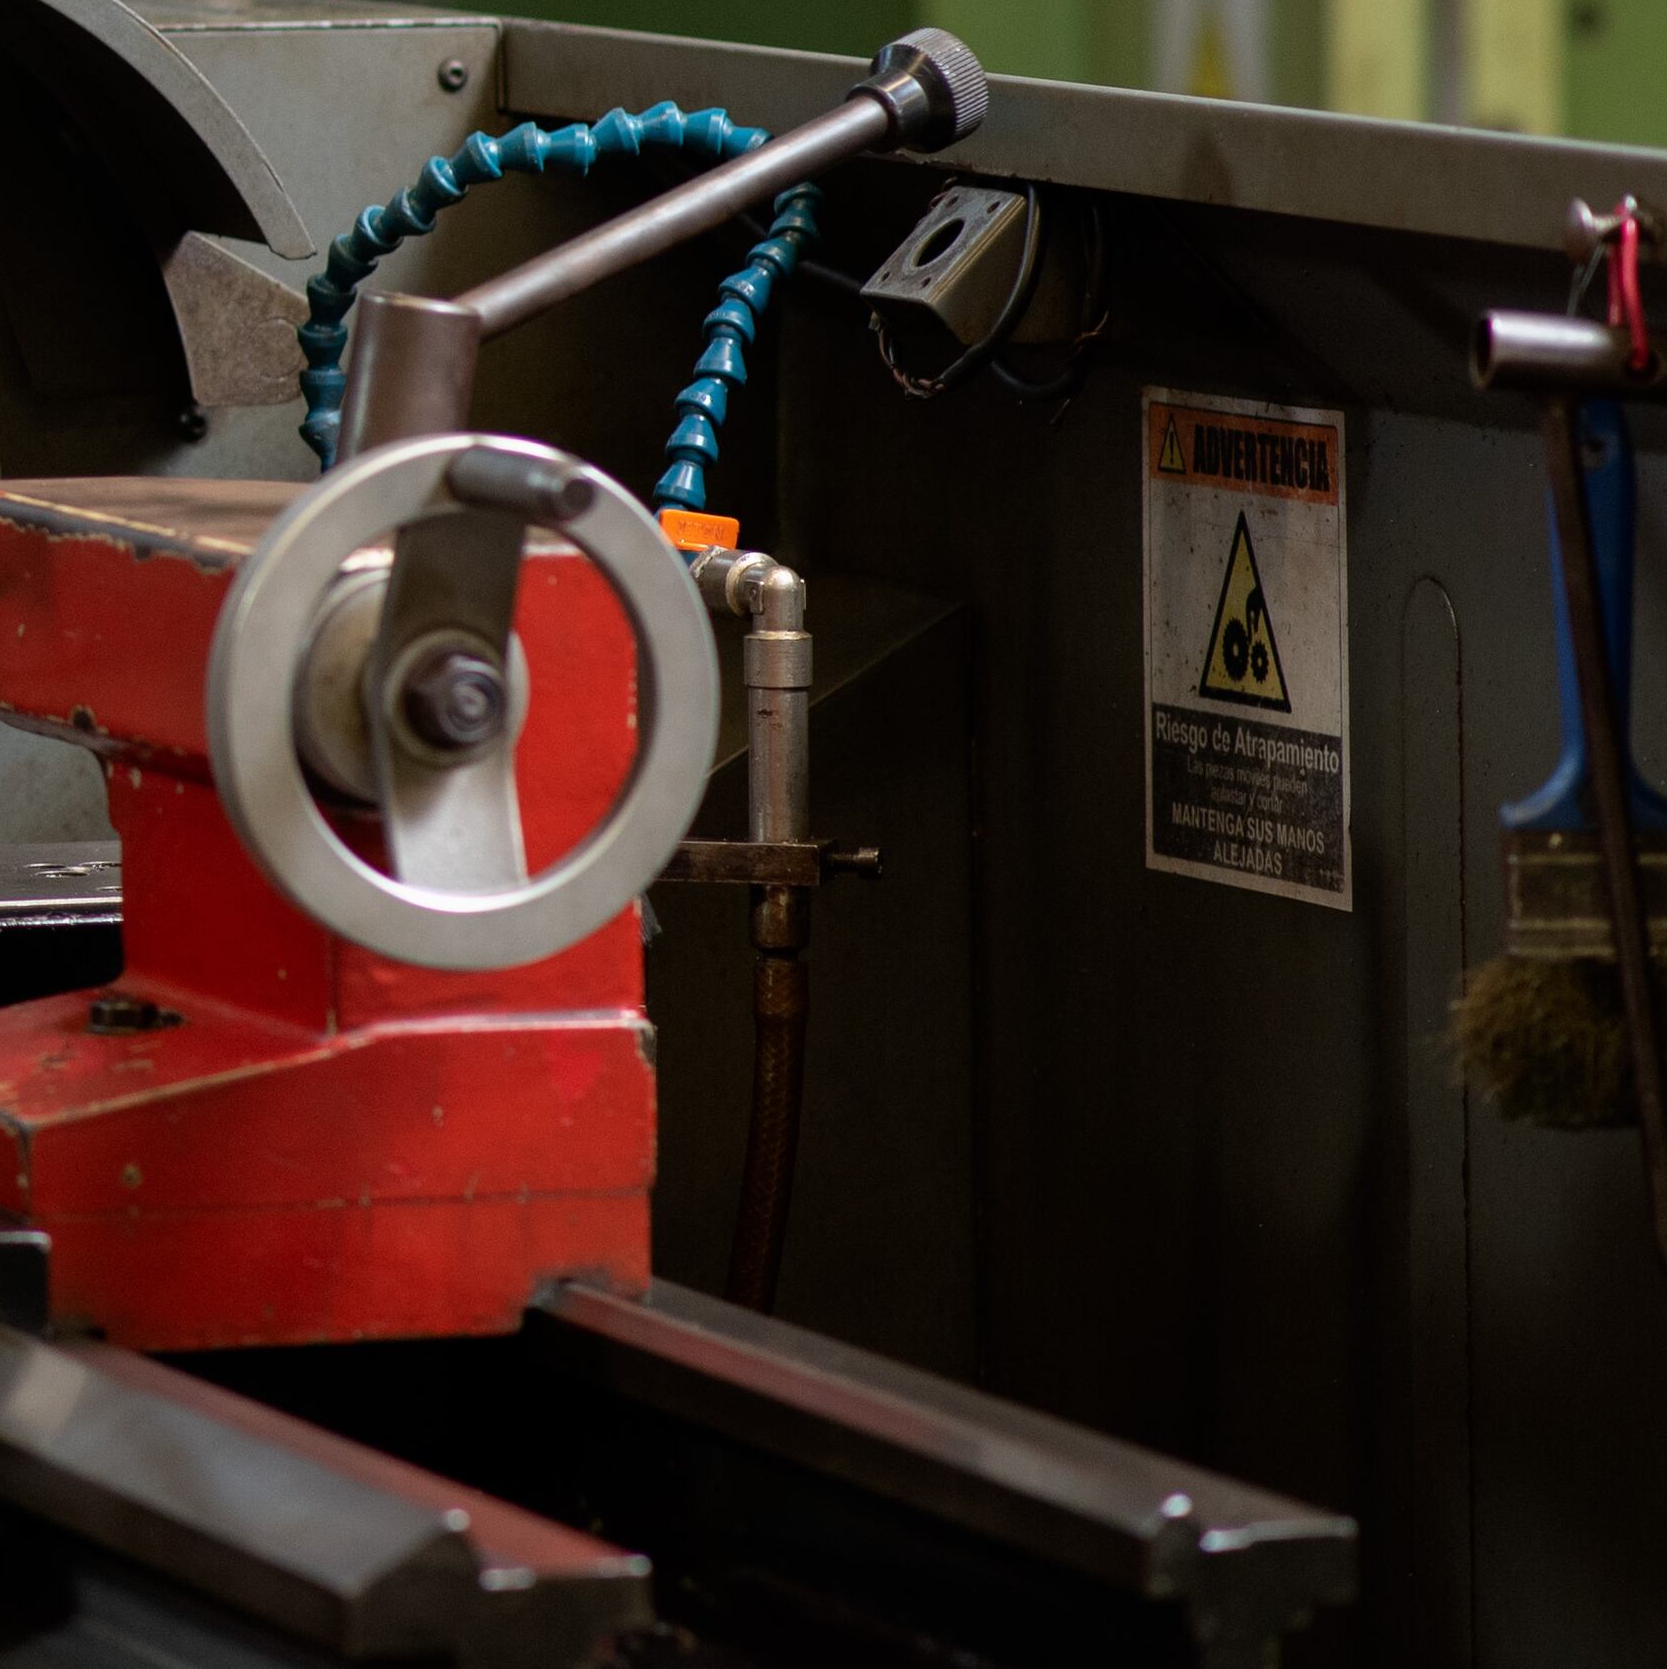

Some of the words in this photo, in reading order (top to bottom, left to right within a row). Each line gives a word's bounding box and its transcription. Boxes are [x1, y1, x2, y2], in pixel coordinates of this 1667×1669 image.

[1194, 423, 1330, 491] ADVERTENCIA
[1155, 711, 1208, 754] Riesgo
[1212, 723, 1231, 752] de
[1234, 726, 1340, 773] Atrapamiento
[1273, 772, 1308, 795] pueden
[1172, 801, 1244, 836] MANTENGA
[1246, 816, 1274, 843] SUS
[1277, 823, 1325, 854] MANOS
[1213, 840, 1283, 875] ALEJADAS
